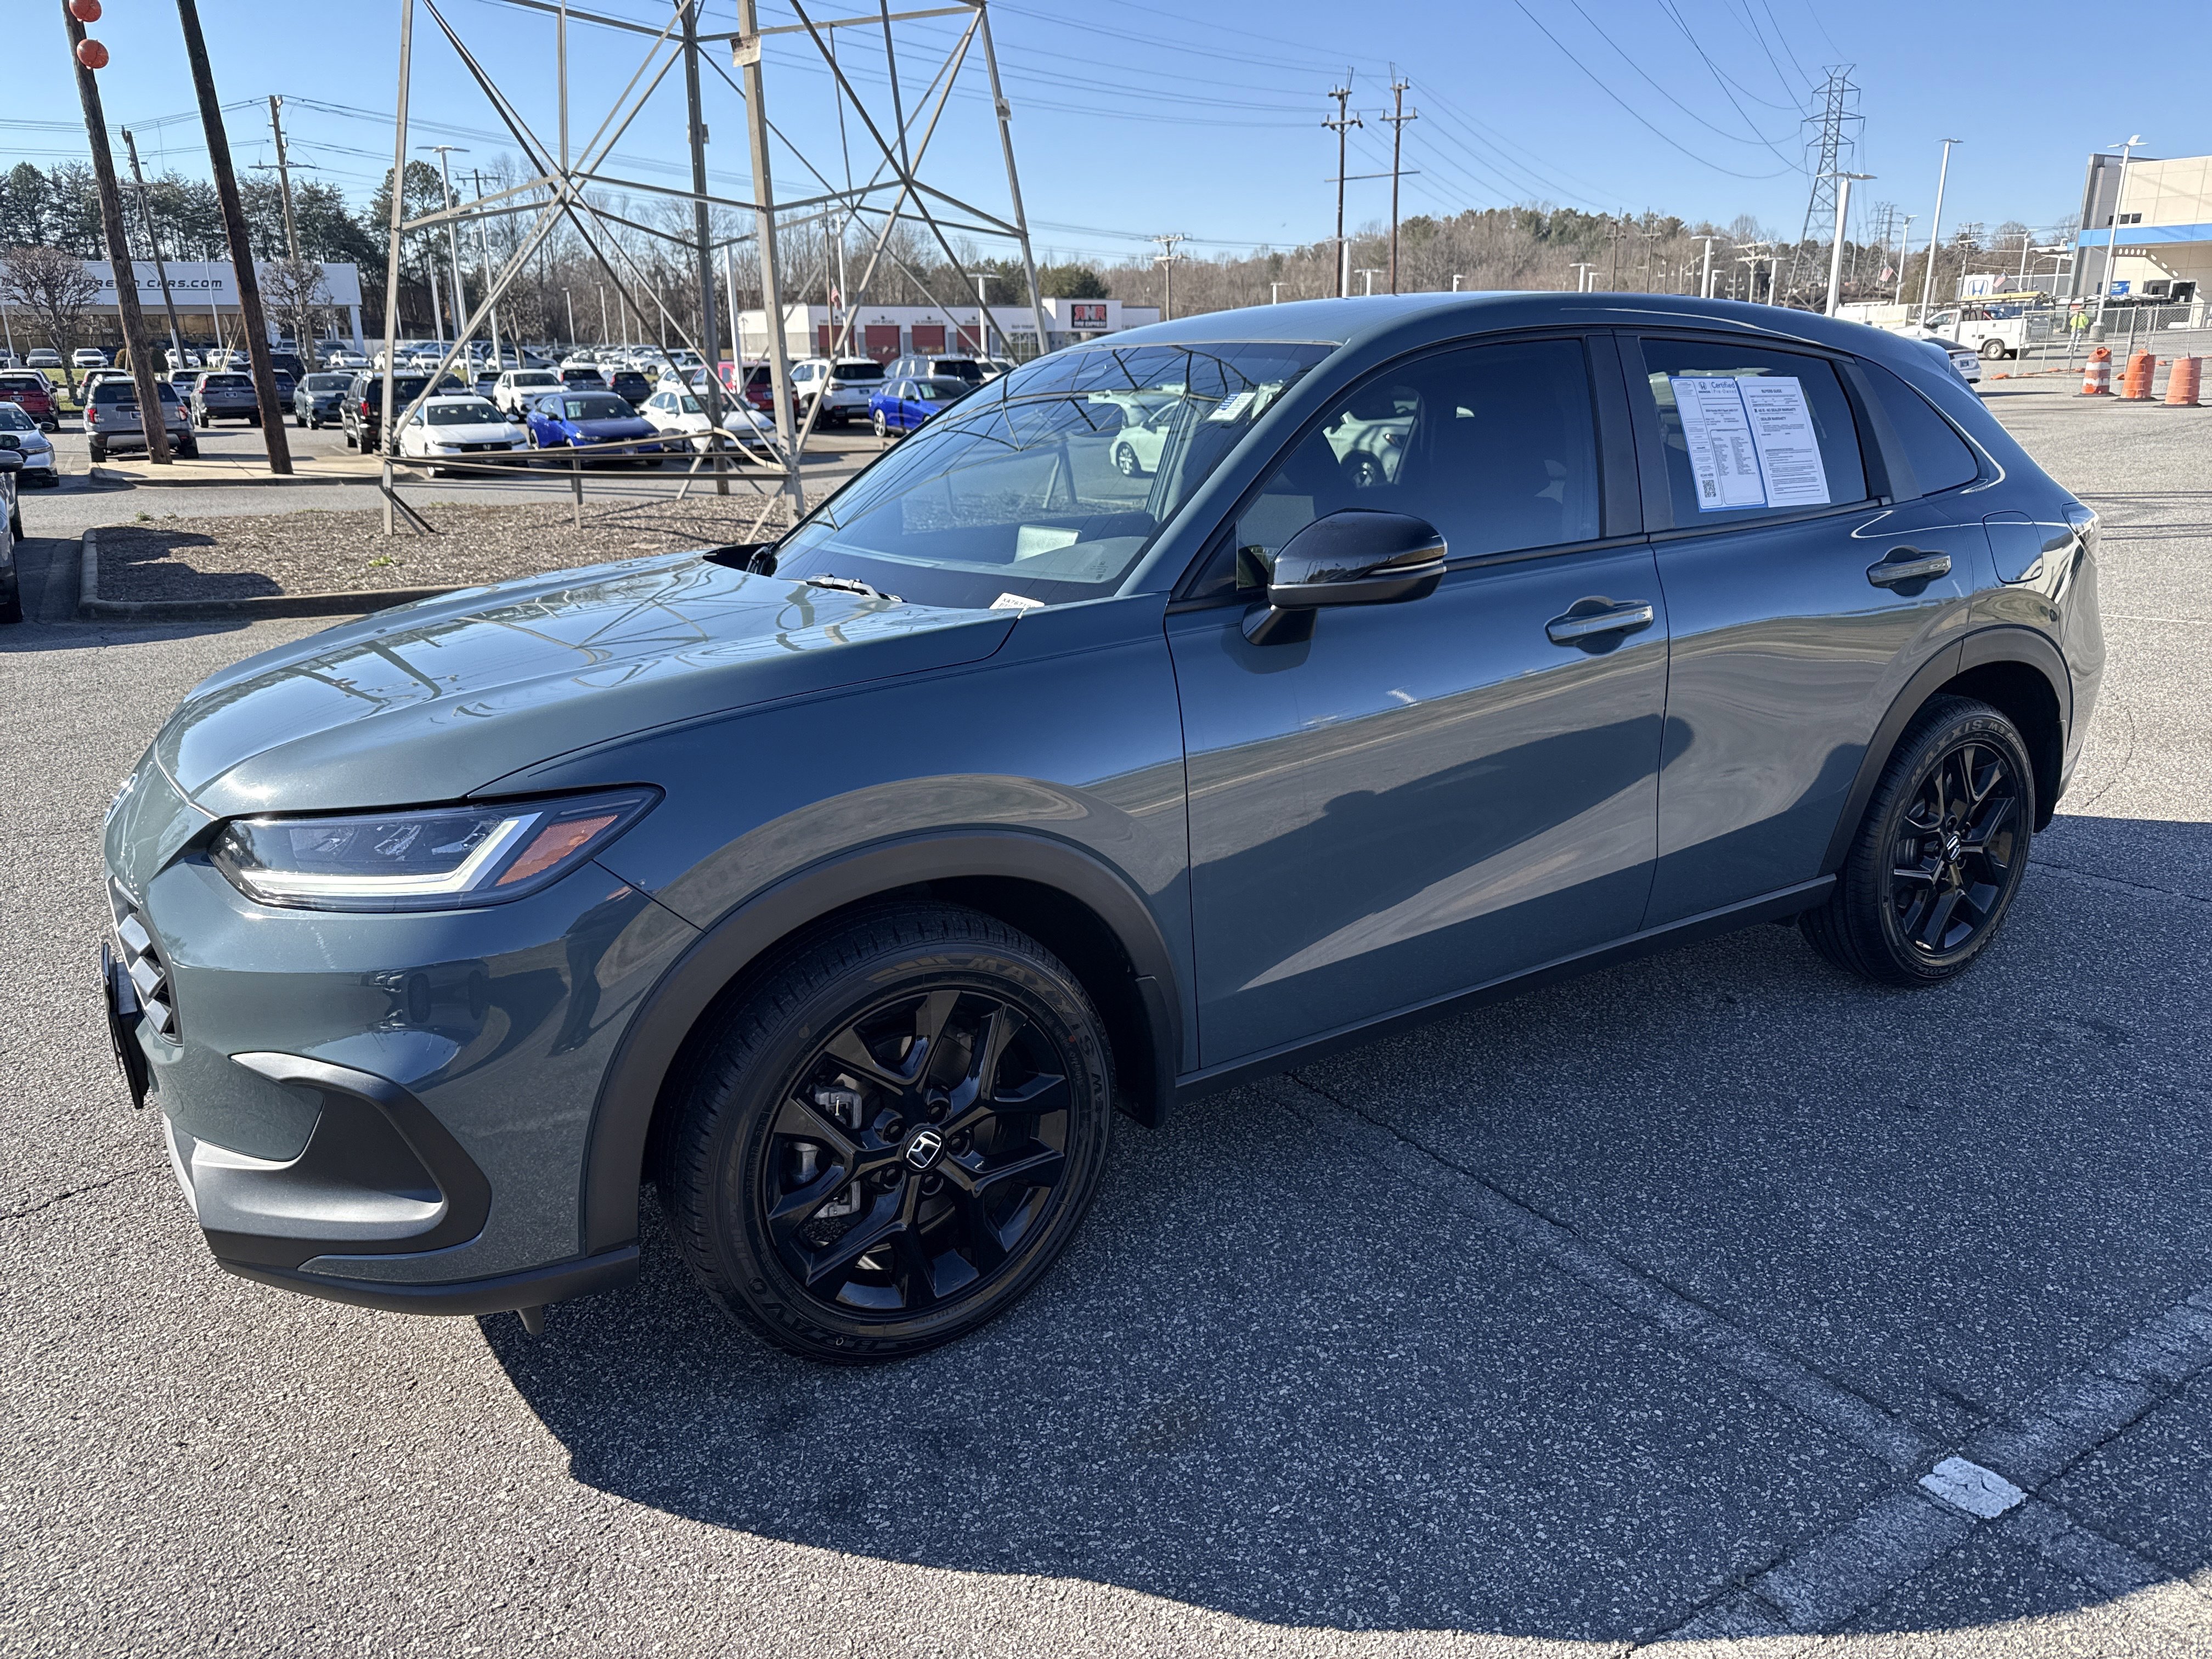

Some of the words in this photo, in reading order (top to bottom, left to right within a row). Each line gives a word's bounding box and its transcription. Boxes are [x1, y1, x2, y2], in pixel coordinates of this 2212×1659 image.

[1074, 306, 1105, 320] RNR
[1911, 719, 1983, 786] MAXXIS
[965, 955, 1094, 1057] MAXXIS
